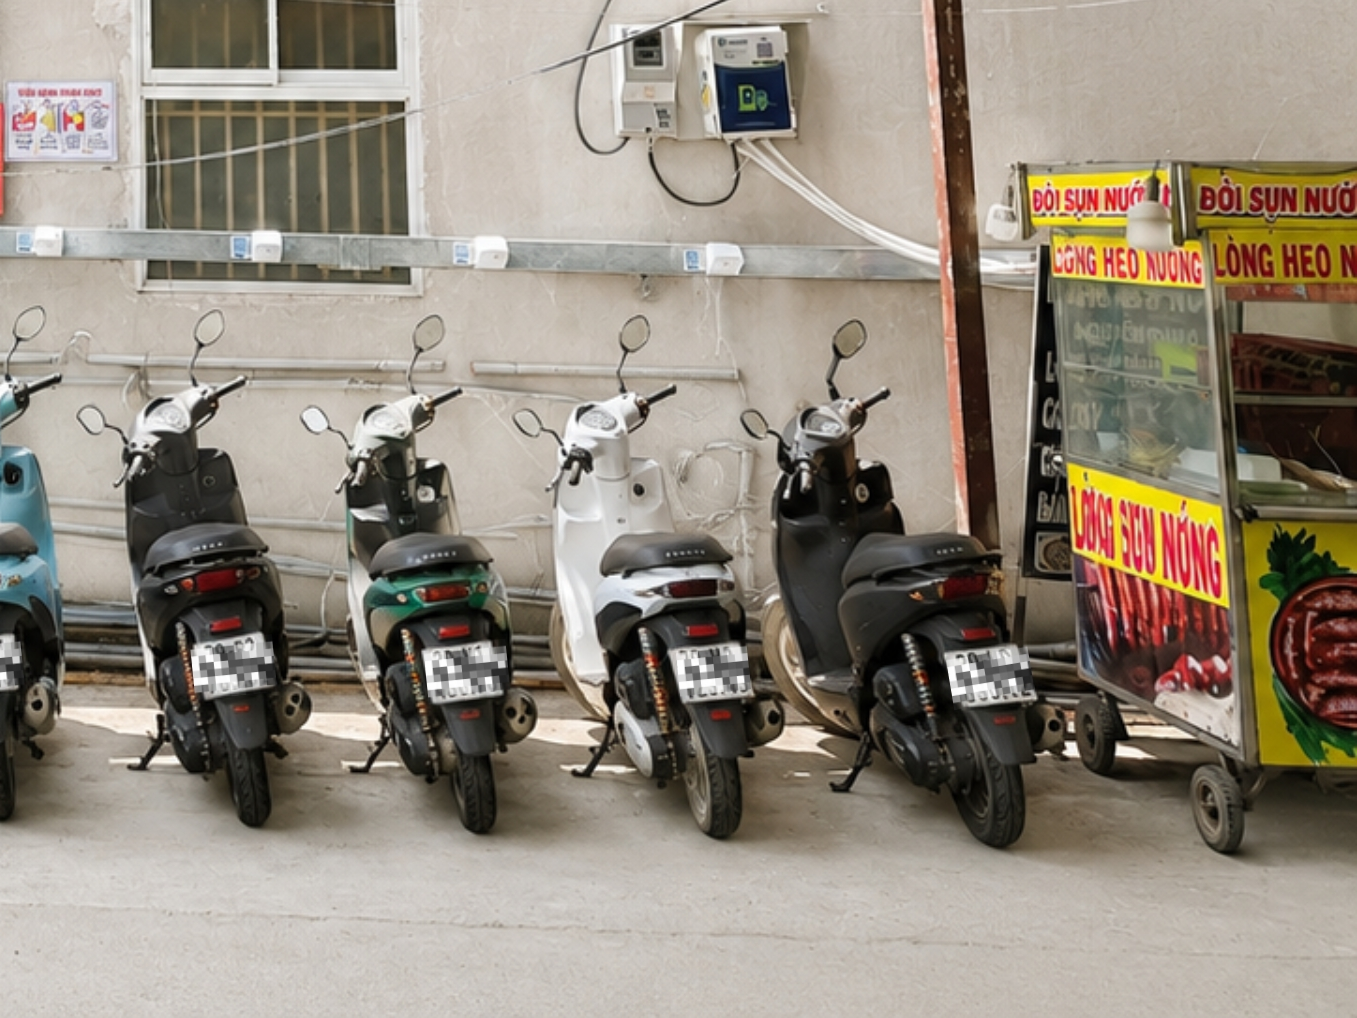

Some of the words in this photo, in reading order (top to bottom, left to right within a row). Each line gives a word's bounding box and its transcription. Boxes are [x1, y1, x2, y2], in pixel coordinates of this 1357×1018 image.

[1103, 247, 1139, 279] HEO
[1213, 234, 1275, 278] LÒNG
[1282, 243, 1331, 278] HEO
[1160, 500, 1222, 599] NÓNG
